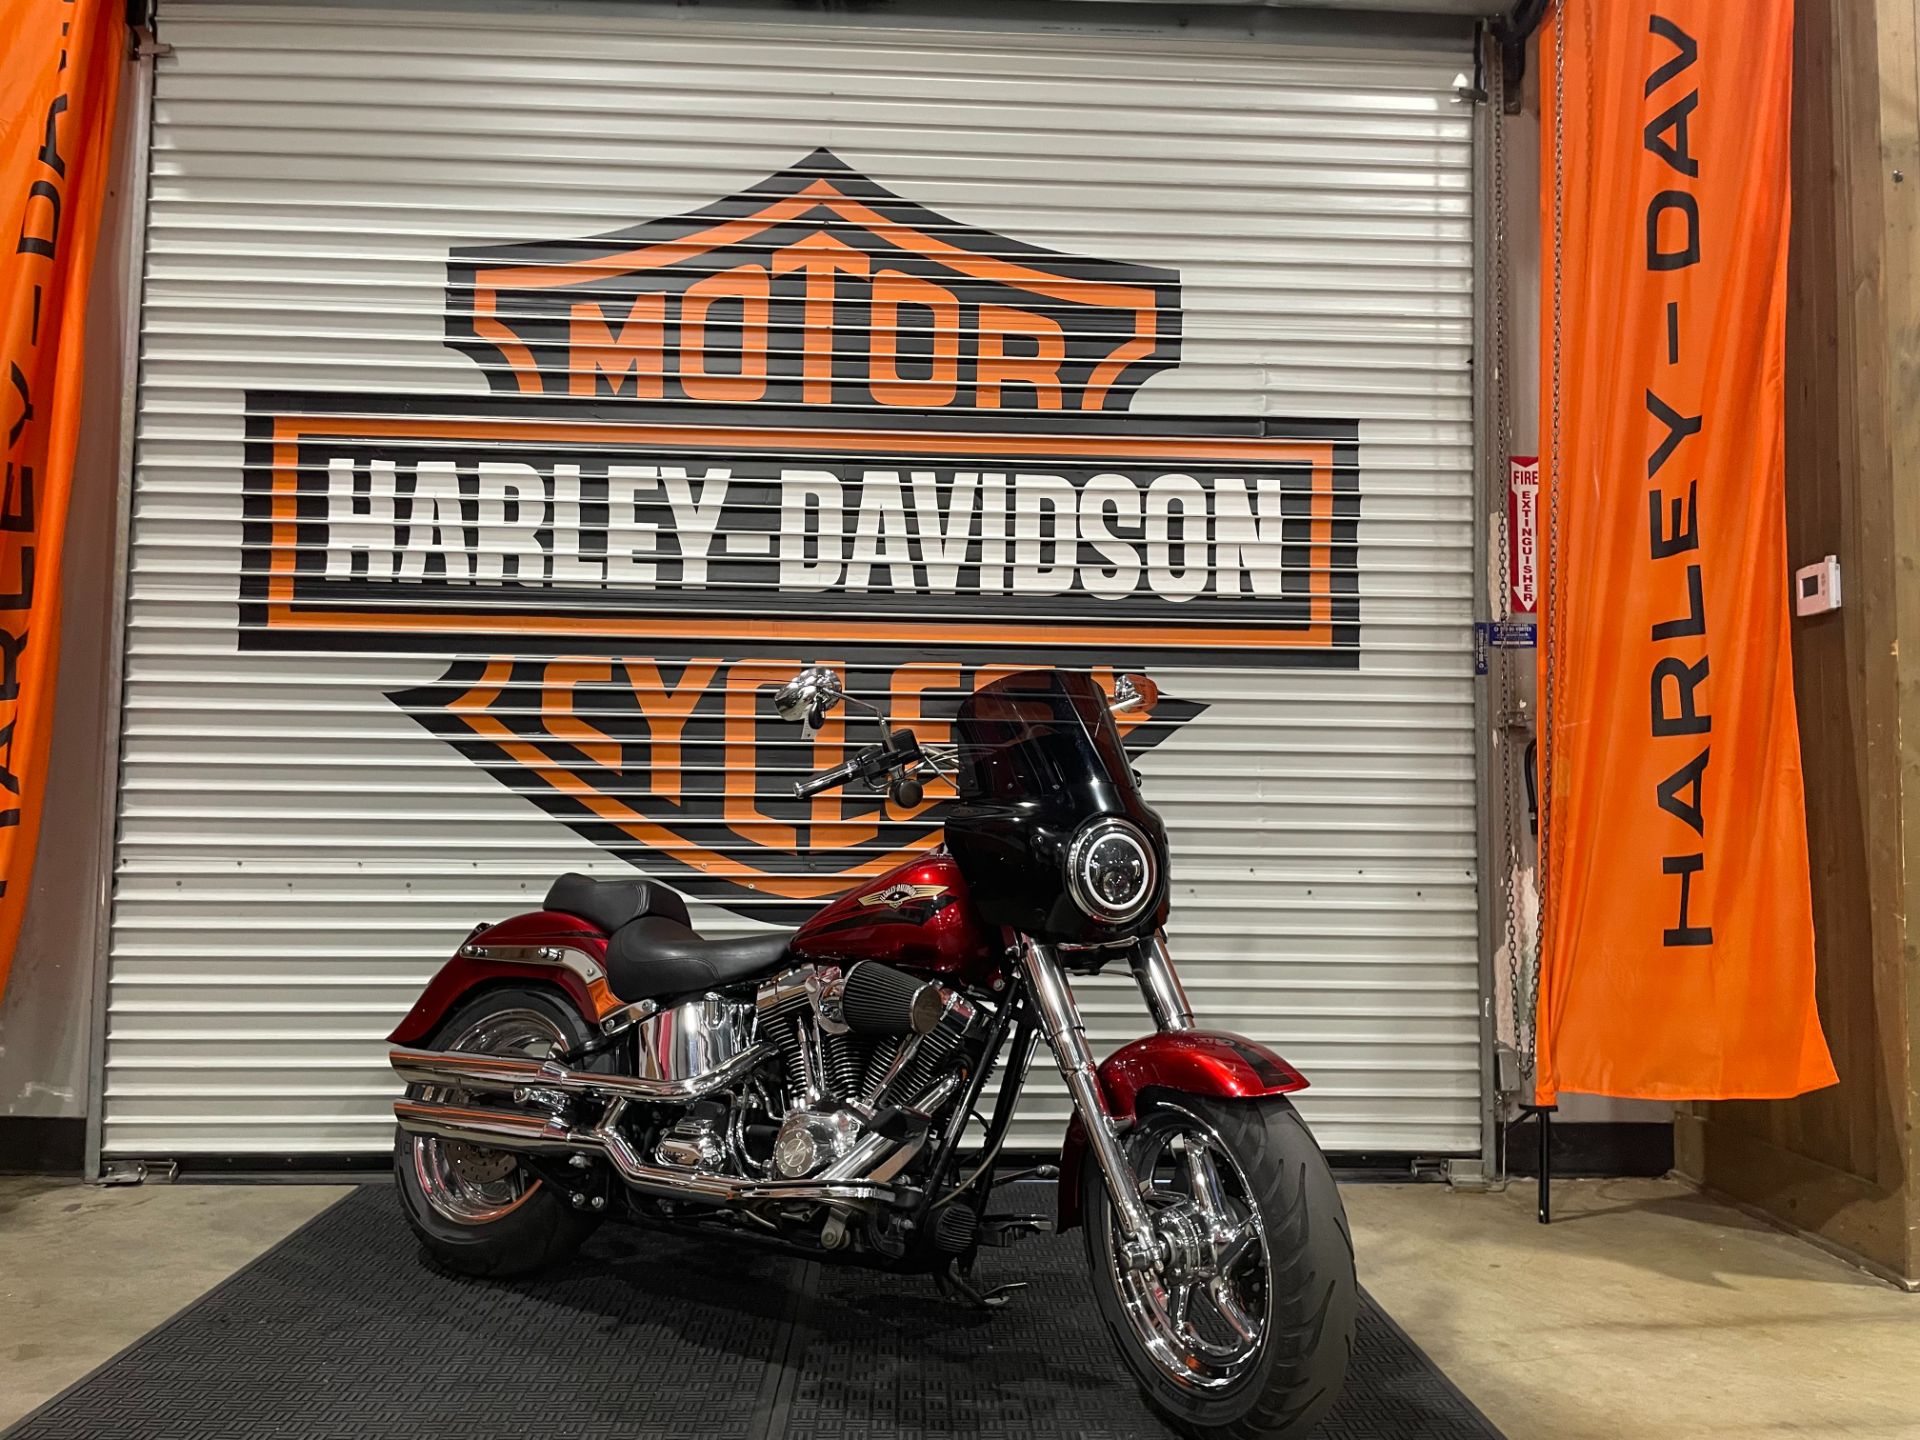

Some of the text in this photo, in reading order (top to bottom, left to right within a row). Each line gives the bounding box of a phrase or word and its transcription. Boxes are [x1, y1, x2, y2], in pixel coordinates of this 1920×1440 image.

[567, 229, 1065, 412] MOTOR
[324, 456, 1283, 603] HARLEY-DAVIDSON
[1513, 470, 1539, 486] FIRE
[1521, 490, 1533, 602] EXTINGUISHER
